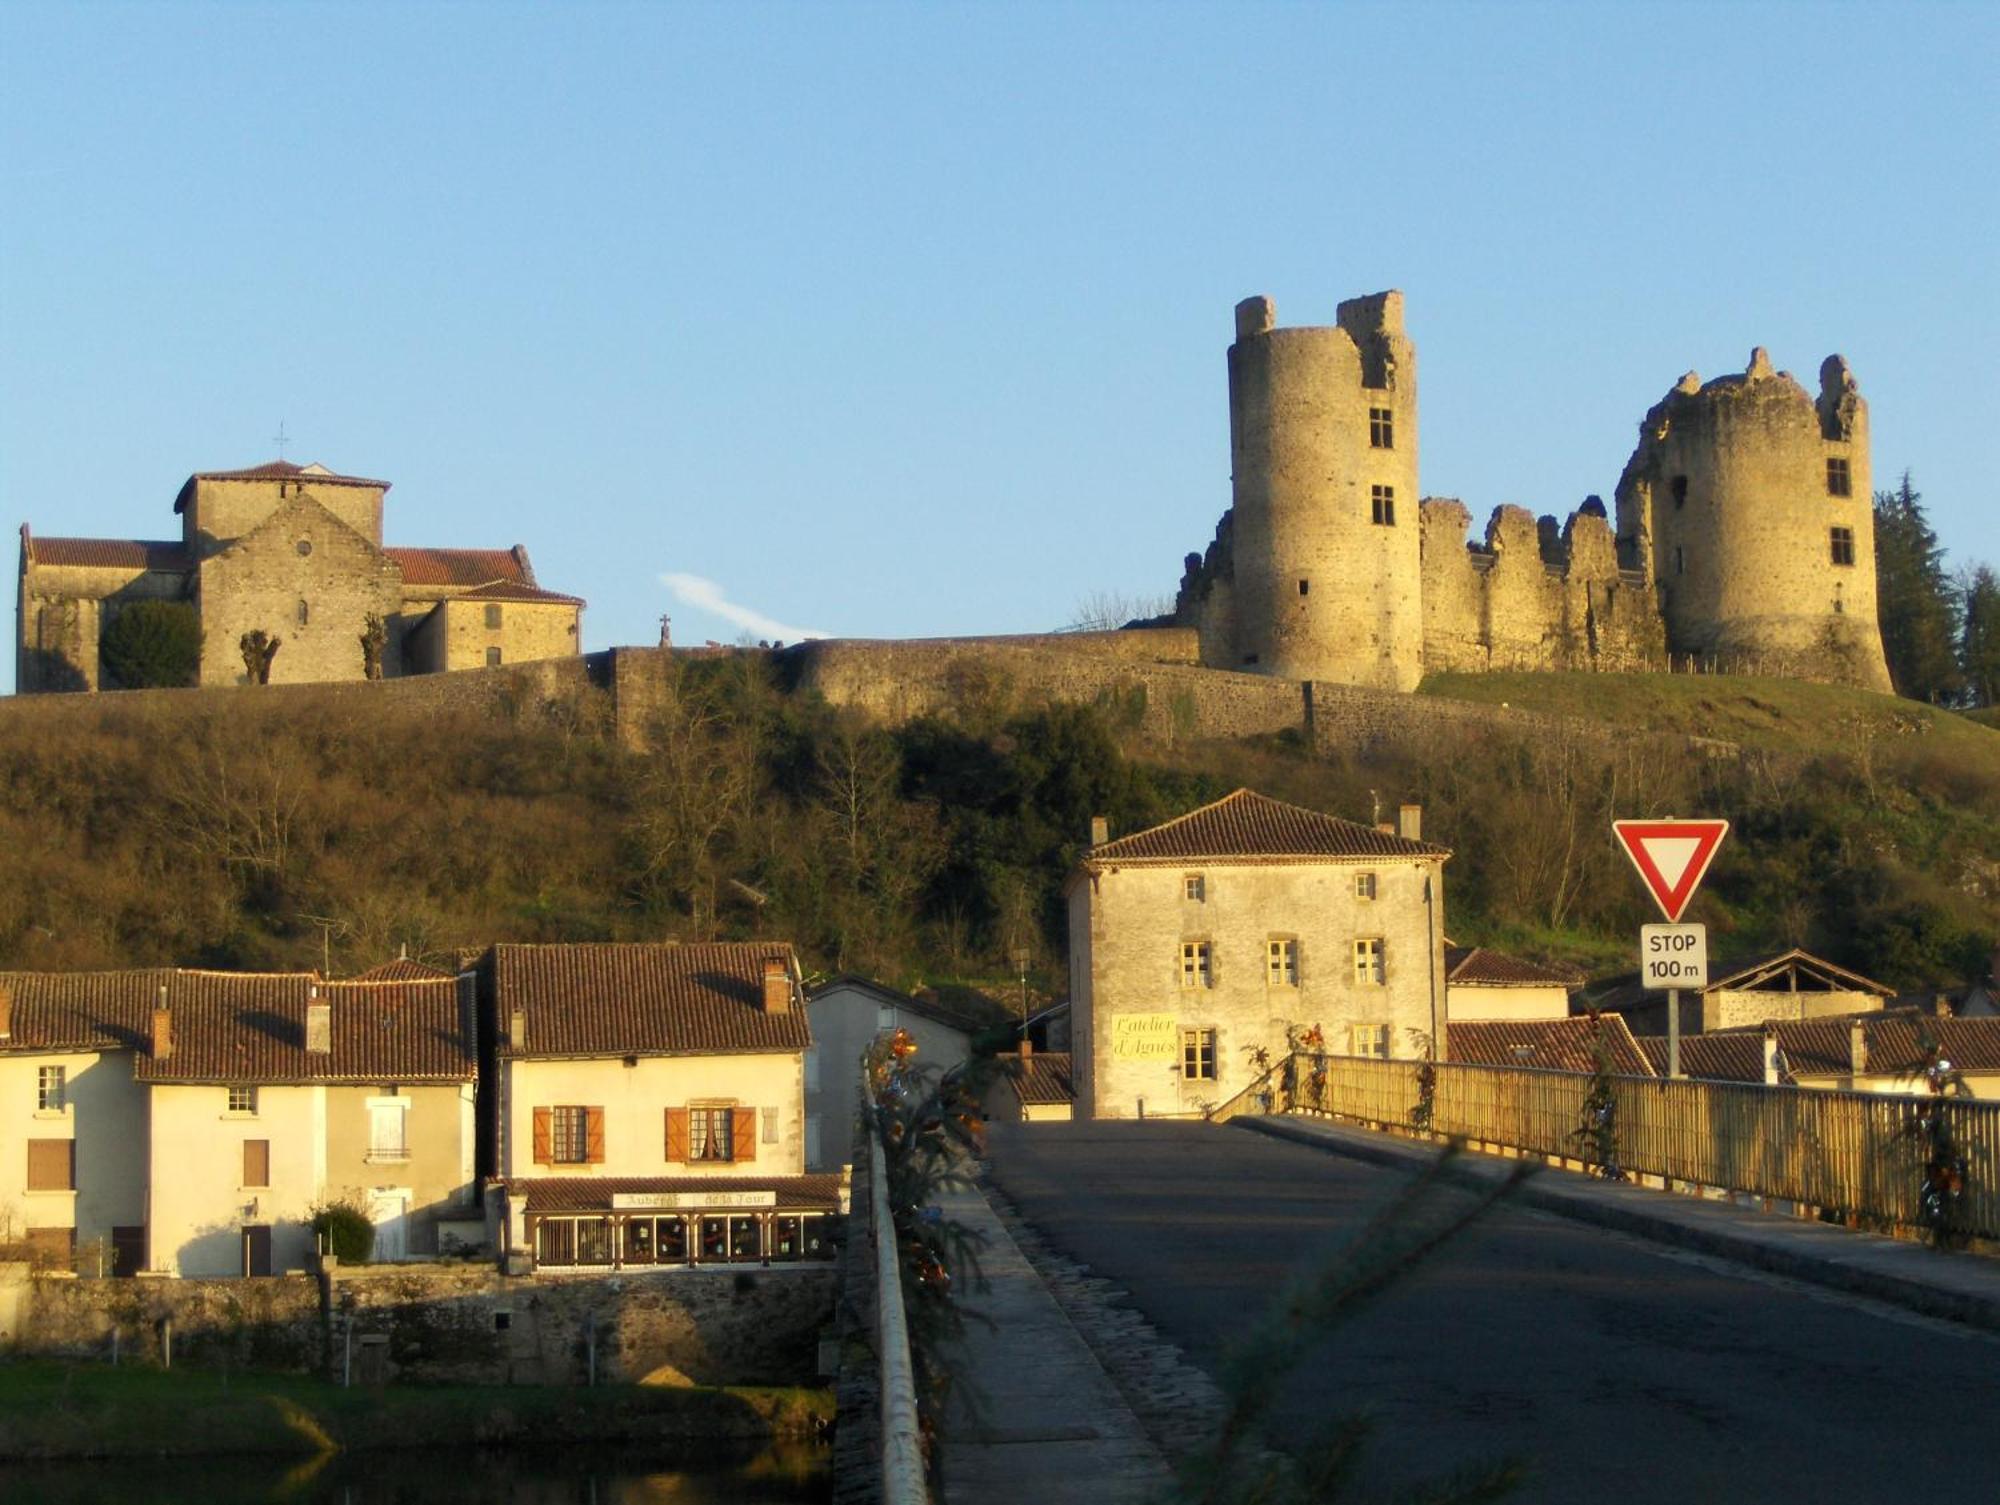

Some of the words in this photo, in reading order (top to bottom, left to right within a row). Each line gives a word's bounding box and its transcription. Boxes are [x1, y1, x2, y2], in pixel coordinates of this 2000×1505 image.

[1650, 934, 1697, 952] STOP
[1649, 961, 1681, 978] 100
[1684, 966, 1699, 976] m
